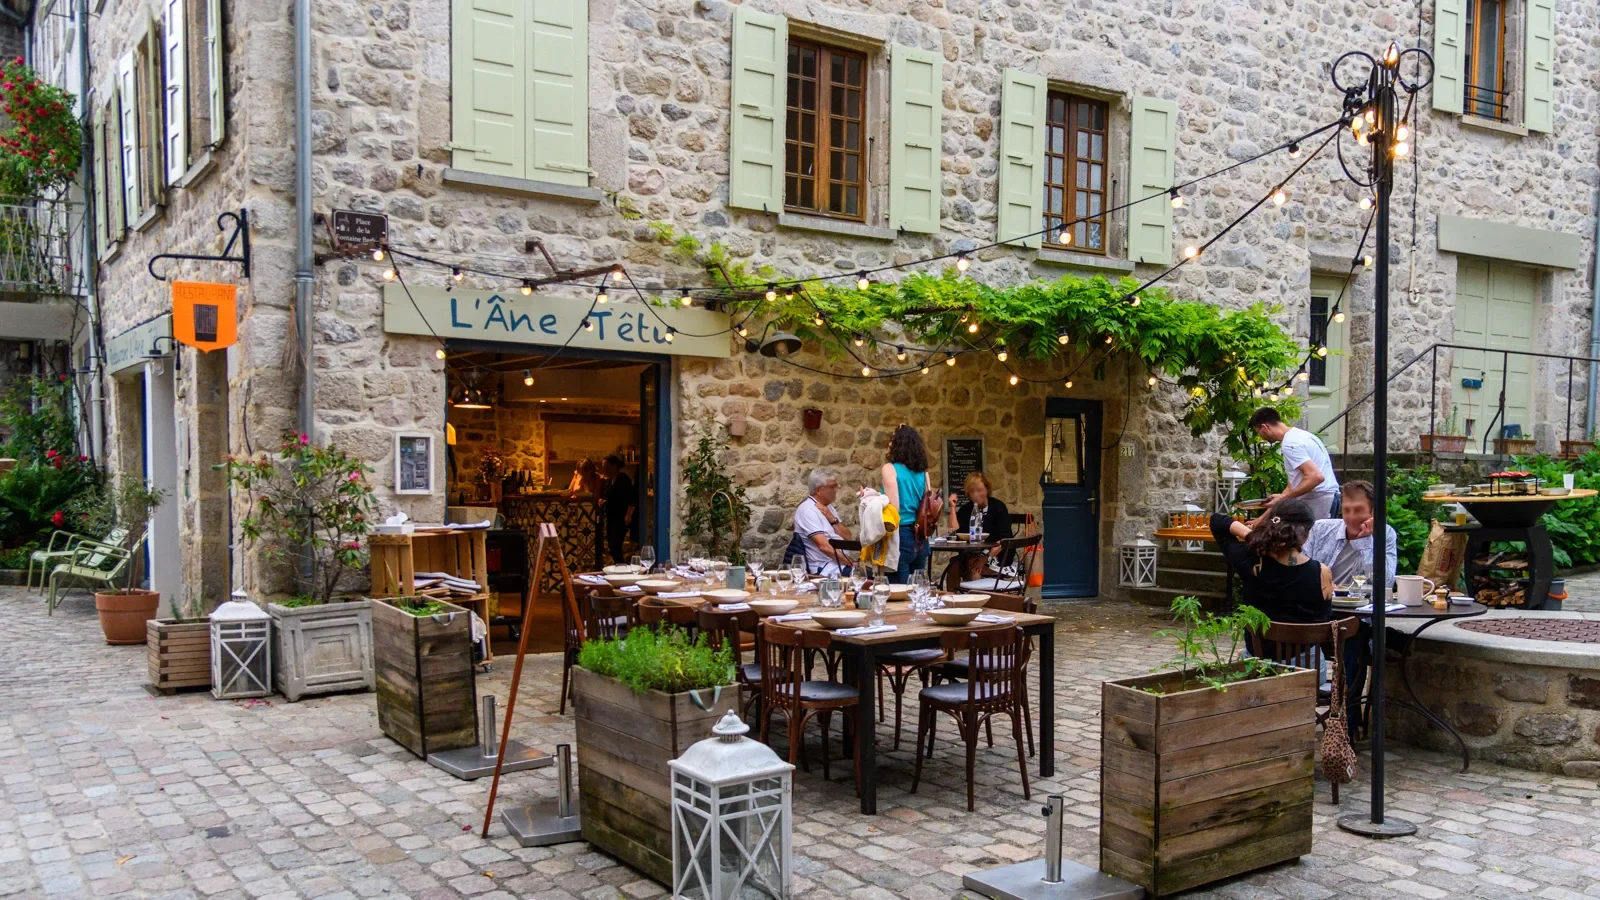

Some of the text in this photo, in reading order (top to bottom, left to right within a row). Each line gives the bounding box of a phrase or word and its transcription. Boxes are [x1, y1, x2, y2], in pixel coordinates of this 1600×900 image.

[355, 217, 371, 225] Place
[450, 294, 674, 345] L'Âne Têtu
